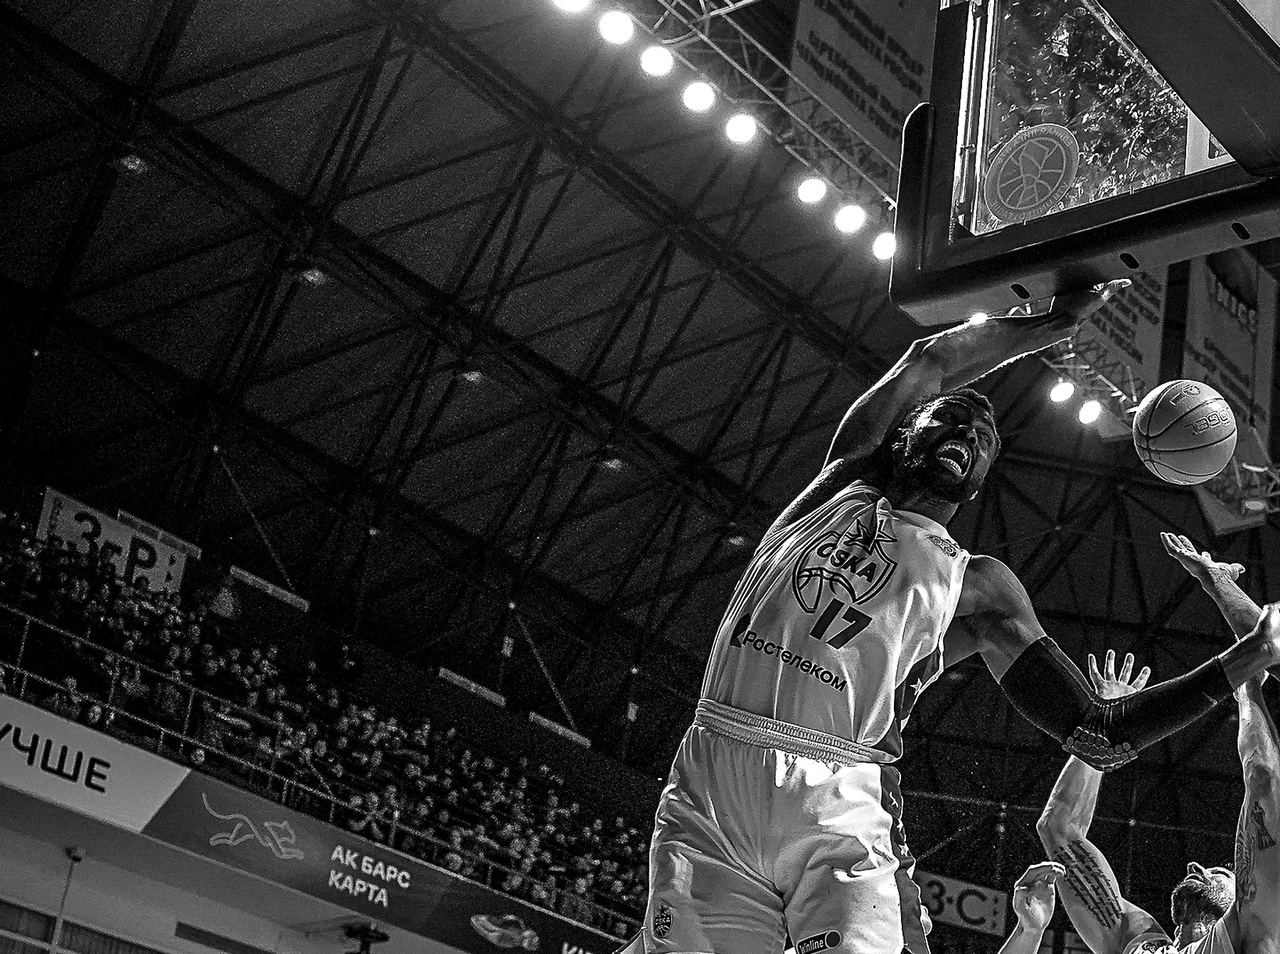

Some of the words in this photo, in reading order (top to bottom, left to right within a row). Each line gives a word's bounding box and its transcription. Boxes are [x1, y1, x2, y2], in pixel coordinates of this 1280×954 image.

[816, 542, 877, 583] CSKA
[808, 598, 873, 651] 17
[742, 631, 847, 693] Ростелеком
[328, 870, 390, 908] КАРТА
[331, 845, 358, 869] АК
[361, 857, 411, 889] БАРС
